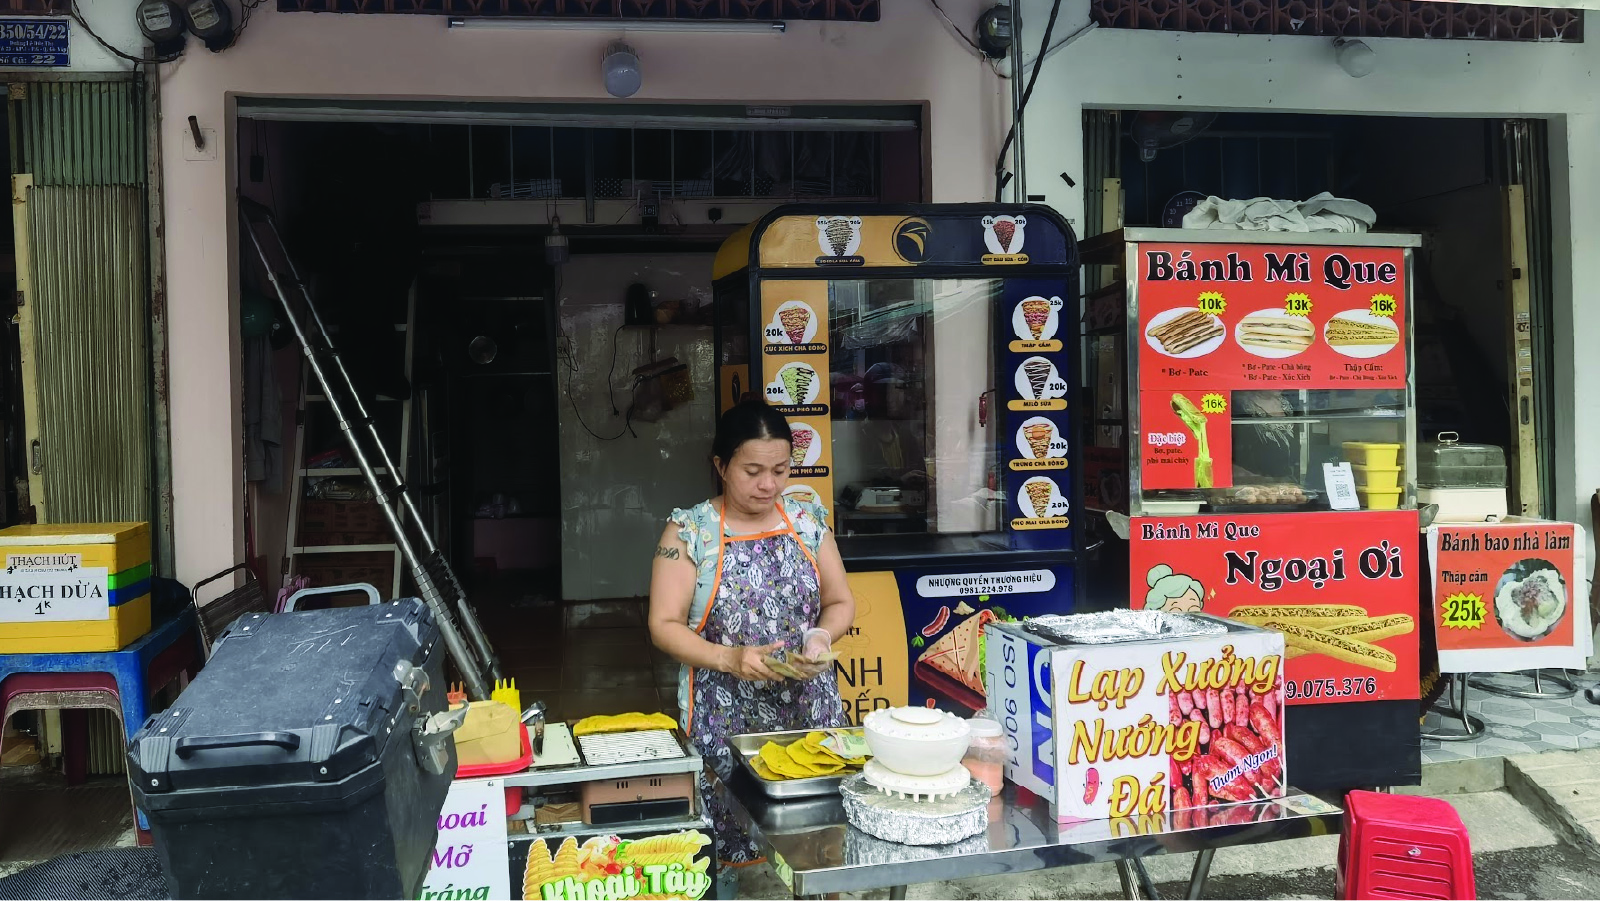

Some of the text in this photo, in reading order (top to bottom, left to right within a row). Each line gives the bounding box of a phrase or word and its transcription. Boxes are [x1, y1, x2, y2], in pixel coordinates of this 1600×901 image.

[31, 55, 55, 63] 22
[1145, 250, 1397, 290] Bánh Mì Que
[1201, 298, 1222, 311] 10k
[1288, 299, 1309, 311] 13k
[1373, 299, 1394, 312] 16k
[1049, 383, 1066, 391] 20k
[1205, 399, 1223, 408] 16k
[1050, 442, 1067, 450] 20k
[1141, 521, 1260, 541] Bánh Mì Que
[1441, 530, 1570, 551] Bánh bao nhà làm
[10, 553, 77, 567] THẠCH HÚT
[1224, 540, 1403, 592] Ngoại Ơi
[0, 580, 102, 602] HẠCH DỪA
[1449, 600, 1481, 621] 25k
[833, 657, 883, 687] NH
[1003, 634, 1016, 688] ISO
[1068, 645, 1281, 711] Lạp Xưởng
[1285, 677, 1376, 699] 9.075.376
[1069, 713, 1201, 765] Nướng
[1210, 745, 1278, 791] Thơm Ngon!
[1108, 772, 1167, 818] Đá
[429, 844, 473, 870] Mỡ
[644, 863, 710, 899] Tây
